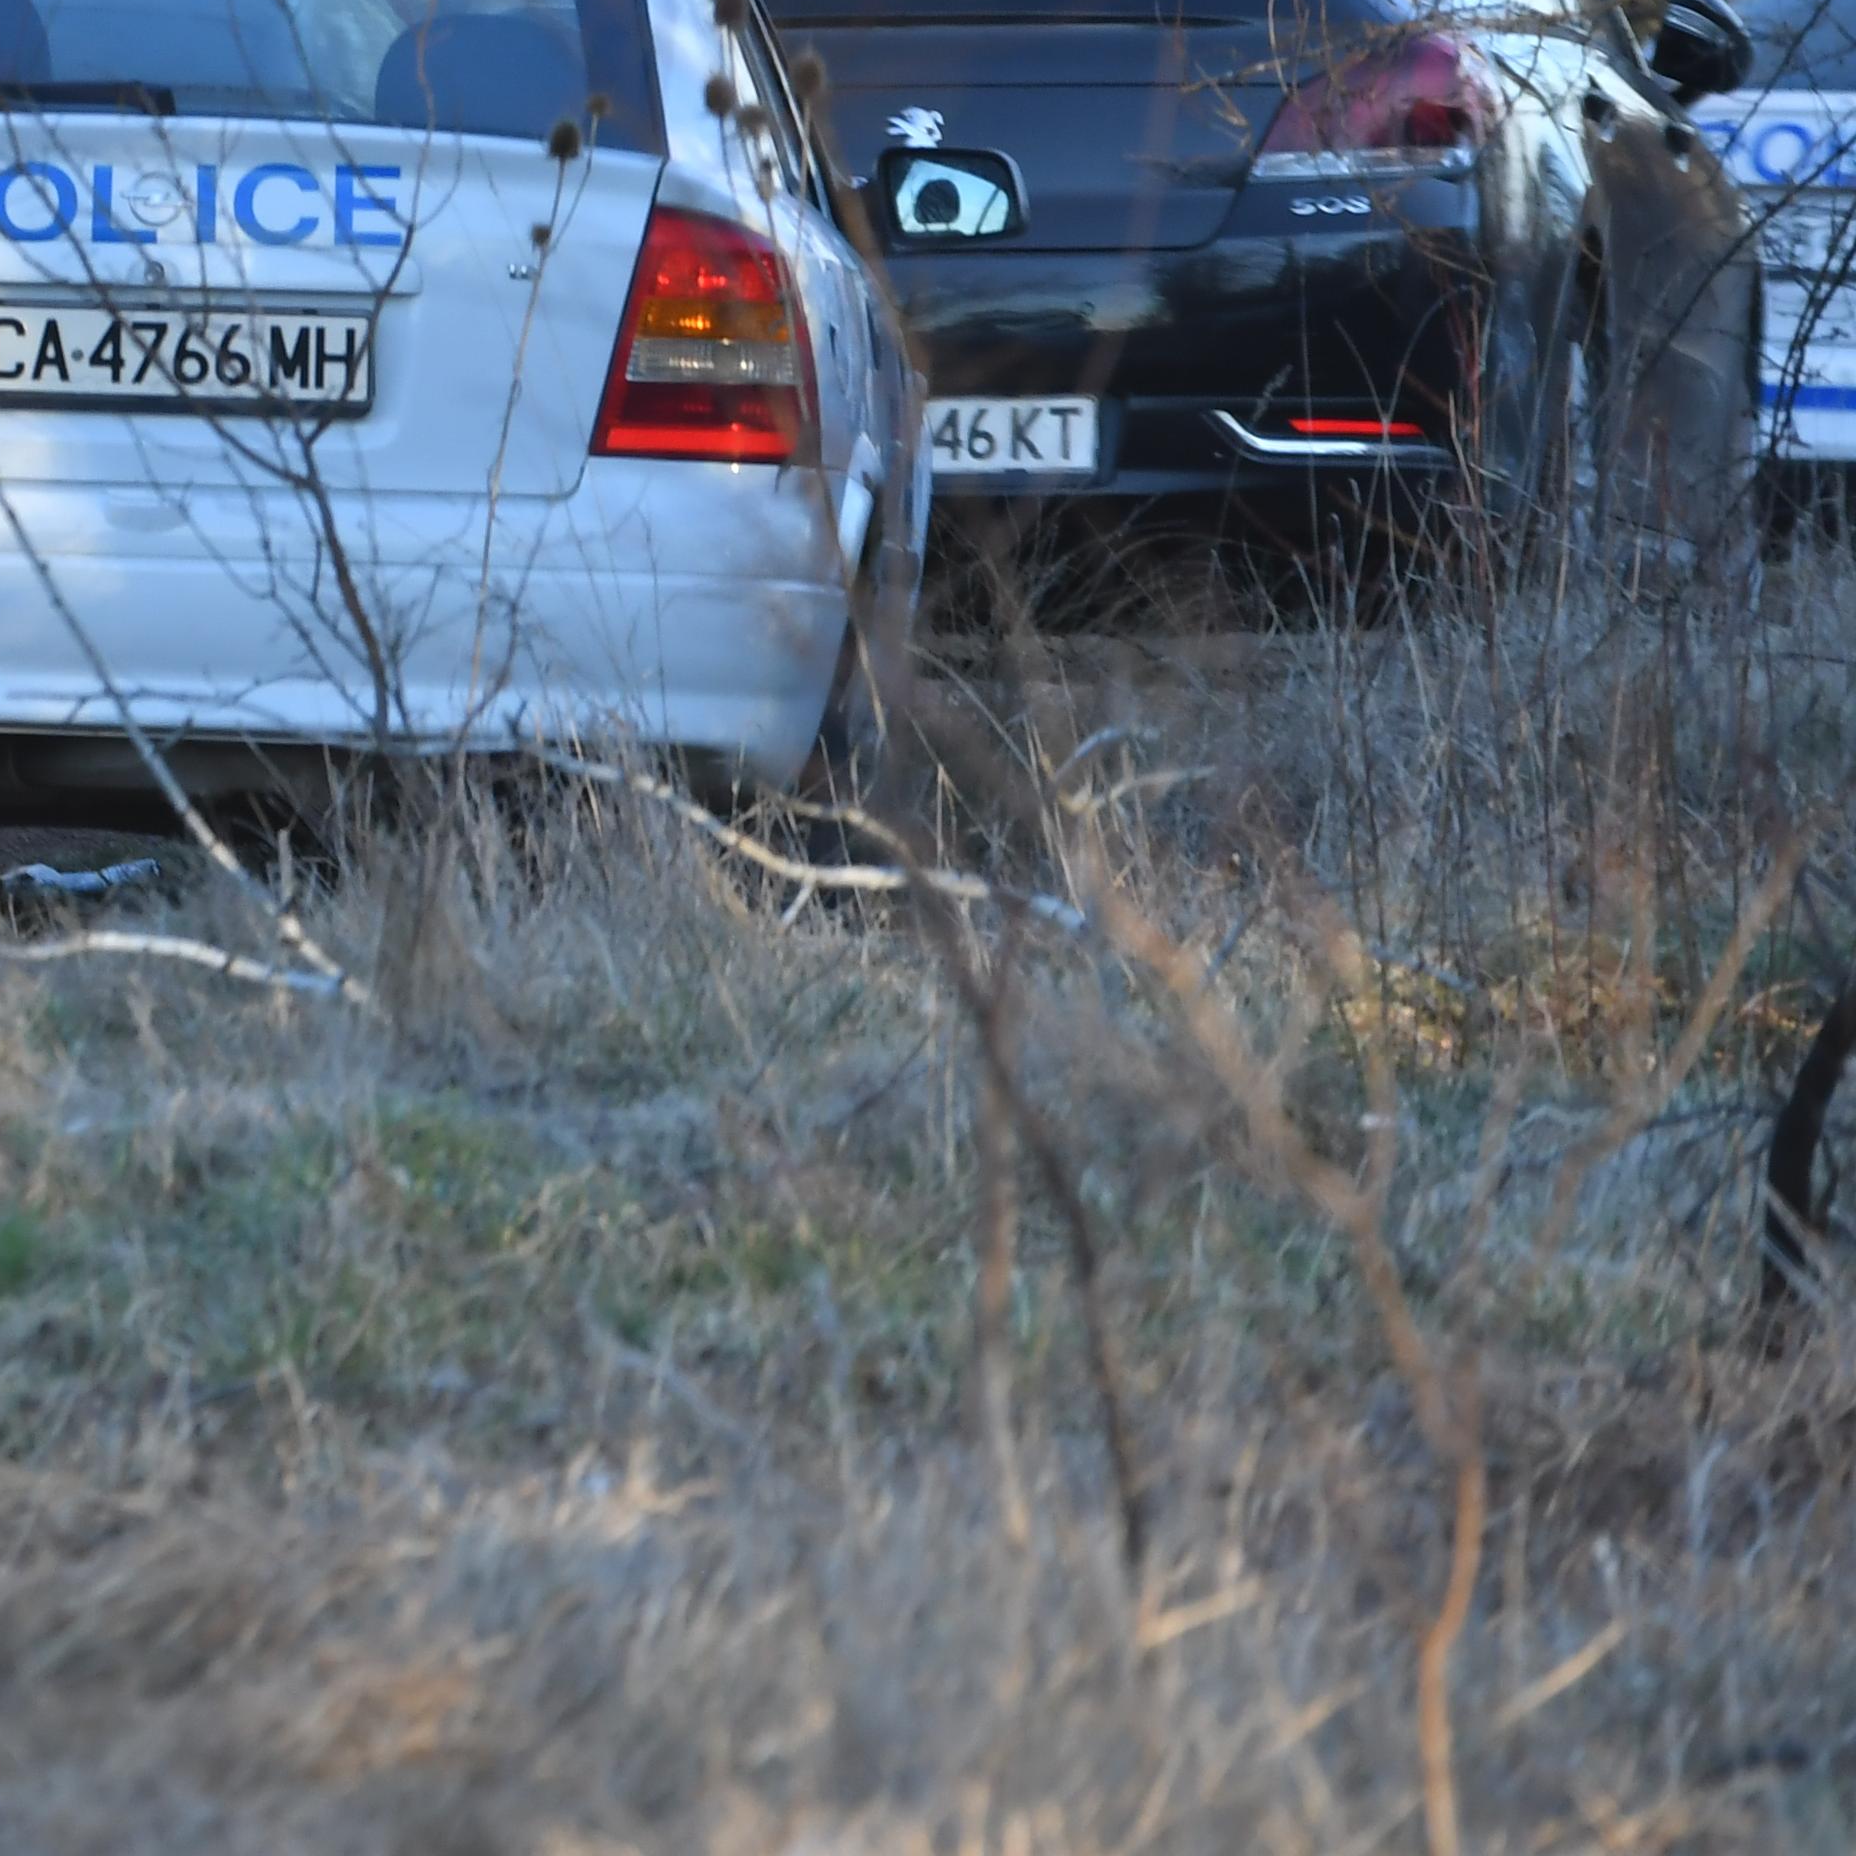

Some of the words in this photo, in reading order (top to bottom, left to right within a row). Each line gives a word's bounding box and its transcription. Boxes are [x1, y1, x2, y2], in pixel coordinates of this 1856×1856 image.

[89, 320, 252, 386] 4766
[269, 325, 356, 390] MH
[1010, 406, 1082, 461] KT
